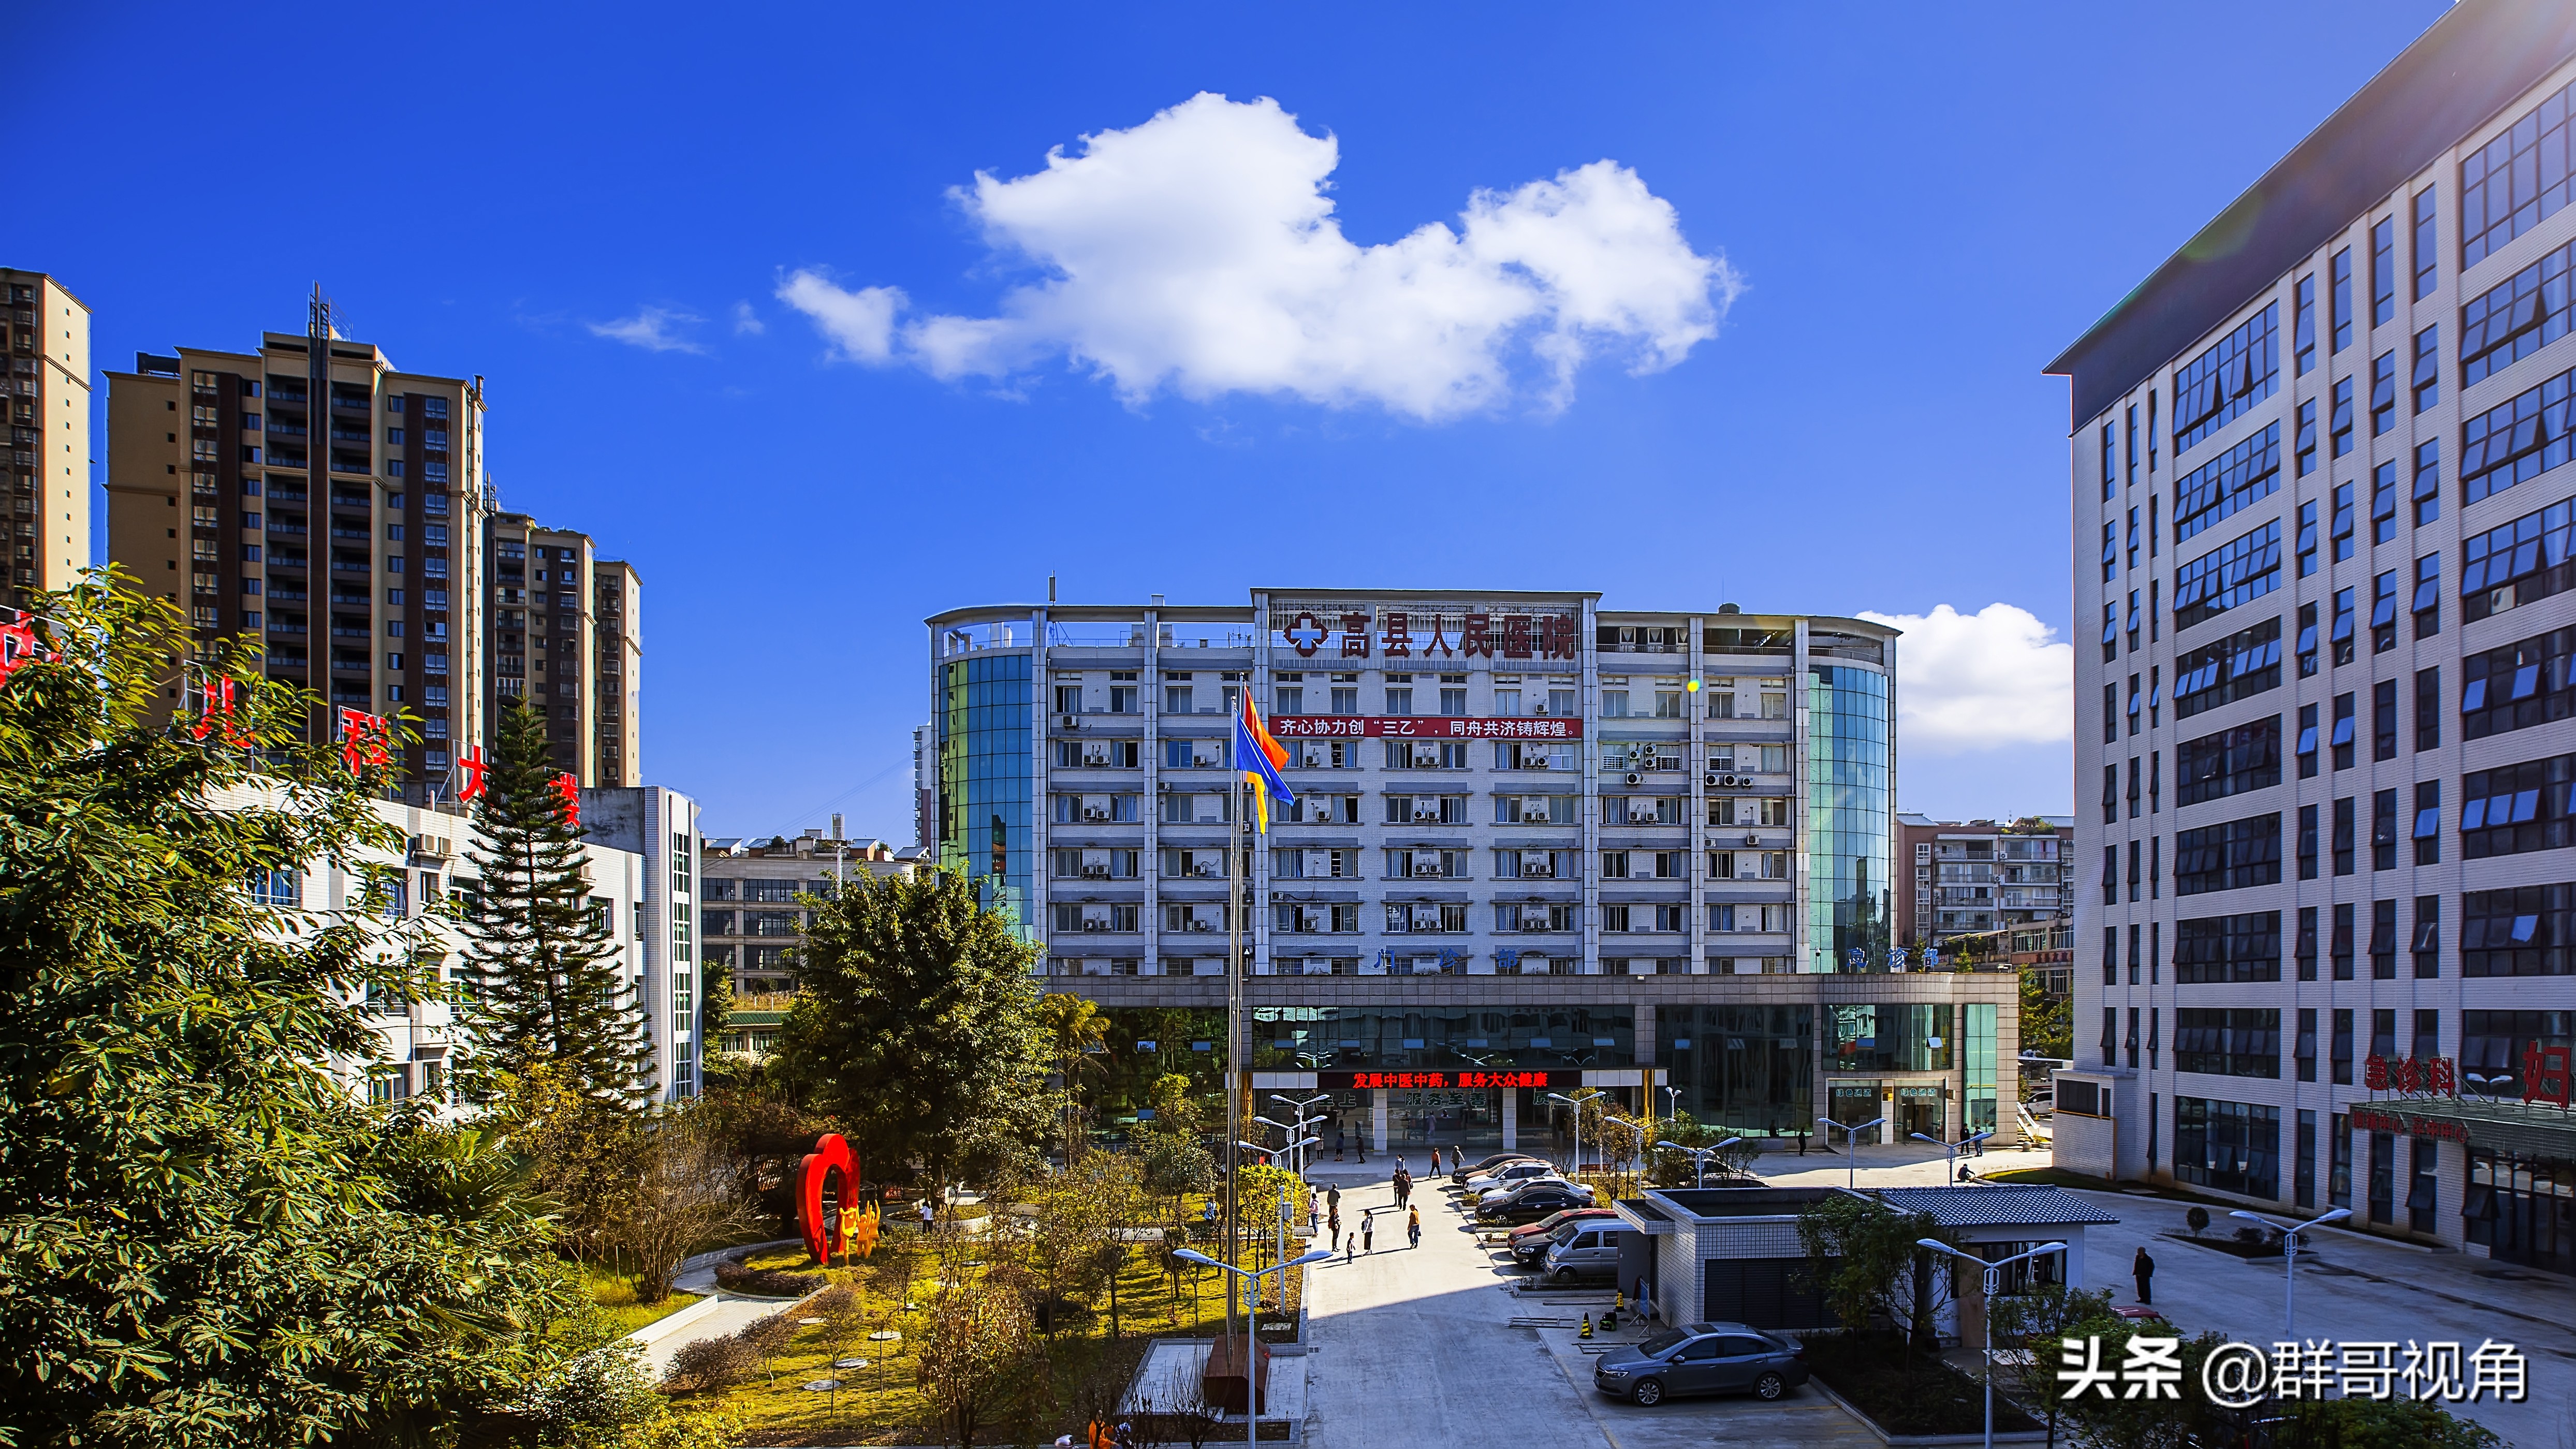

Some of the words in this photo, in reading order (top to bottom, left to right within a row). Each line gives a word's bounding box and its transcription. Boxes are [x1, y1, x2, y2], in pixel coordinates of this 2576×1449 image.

[1340, 611, 1575, 660] 高县人民医院
[1280, 719, 1573, 737] 齐心协力创“三乙”，同舟共济铸辉煌。
[1373, 948, 1518, 969] 门诊部
[1847, 947, 1939, 968] 急诊部
[1353, 1073, 1548, 1088] 发展中医中药，服务大众健康
[2365, 1054, 2456, 1099] 急诊科
[2523, 1041, 2571, 1108] 妇
[1405, 1092, 1487, 1106] 服务至善
[1836, 1089, 1871, 1097] 绿色通道
[1900, 1088, 1936, 1096] 绿色通道
